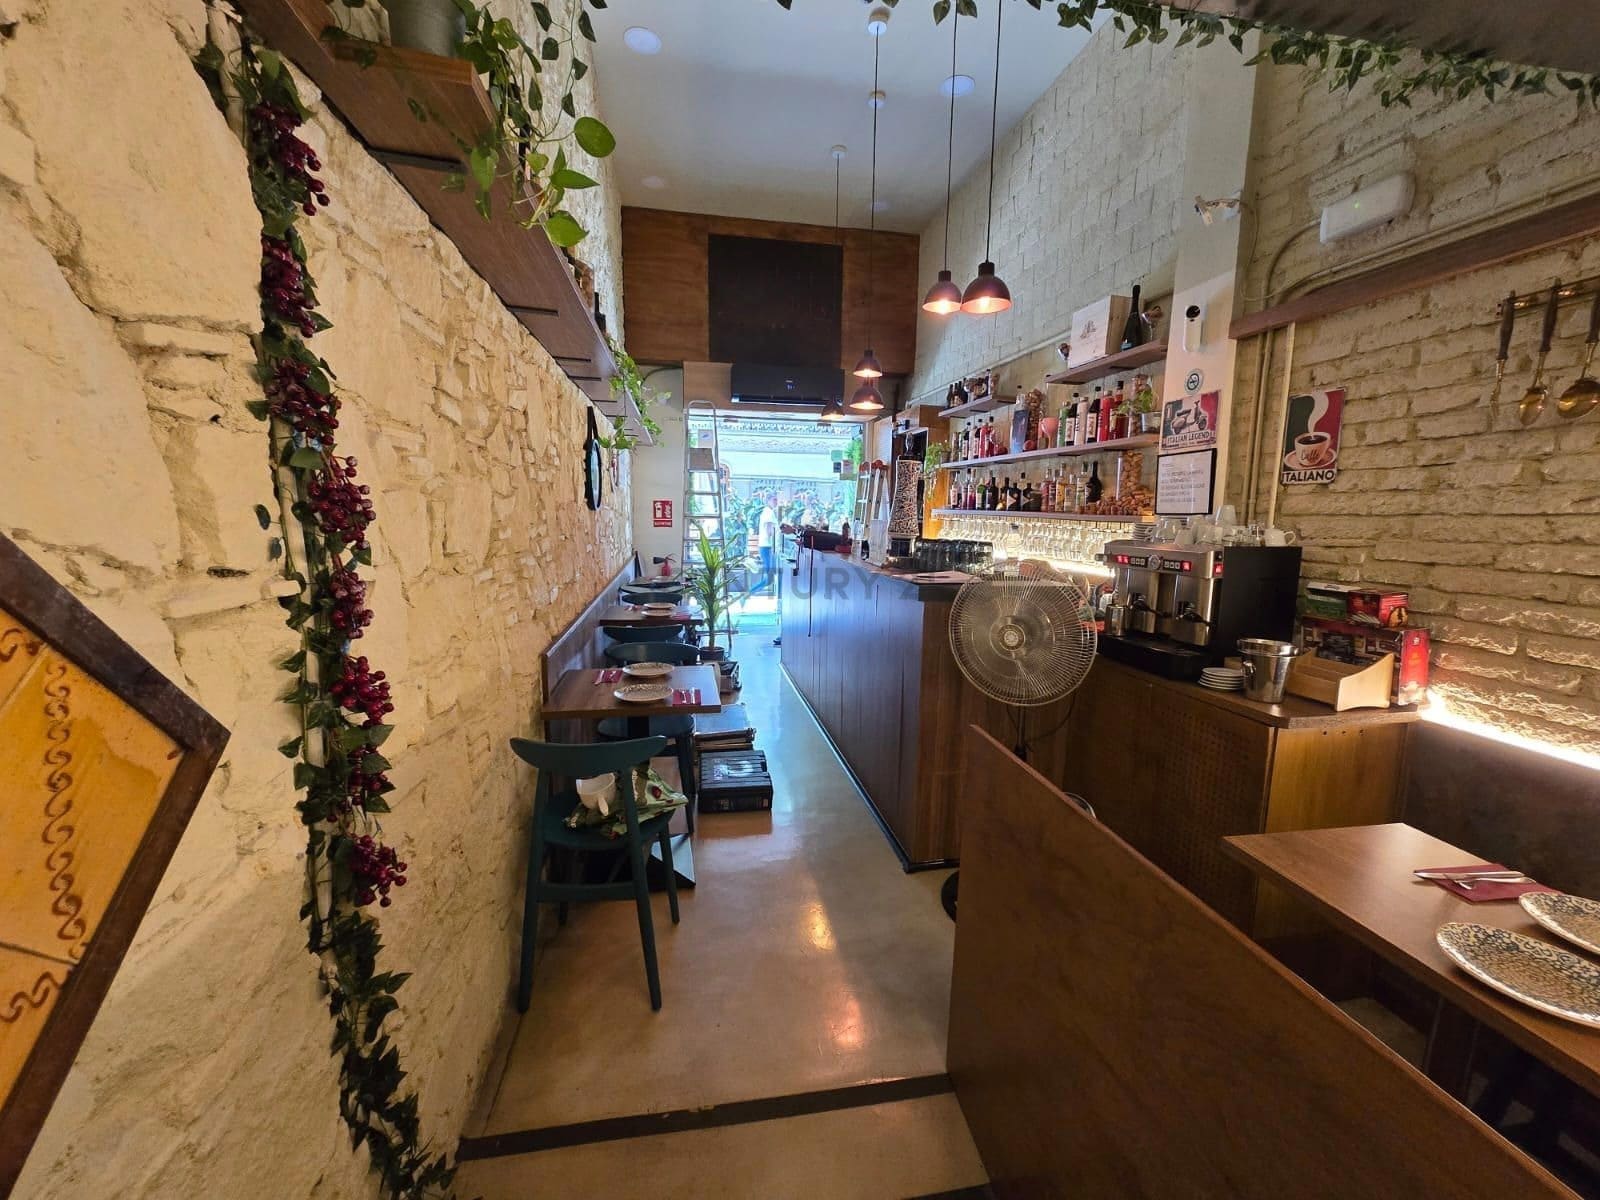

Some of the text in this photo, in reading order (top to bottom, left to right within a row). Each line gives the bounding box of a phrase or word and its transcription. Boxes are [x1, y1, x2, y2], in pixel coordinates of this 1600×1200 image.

[1167, 431, 1210, 444] ITALIAN LEGEND
[1282, 470, 1336, 482] ITALIANO
